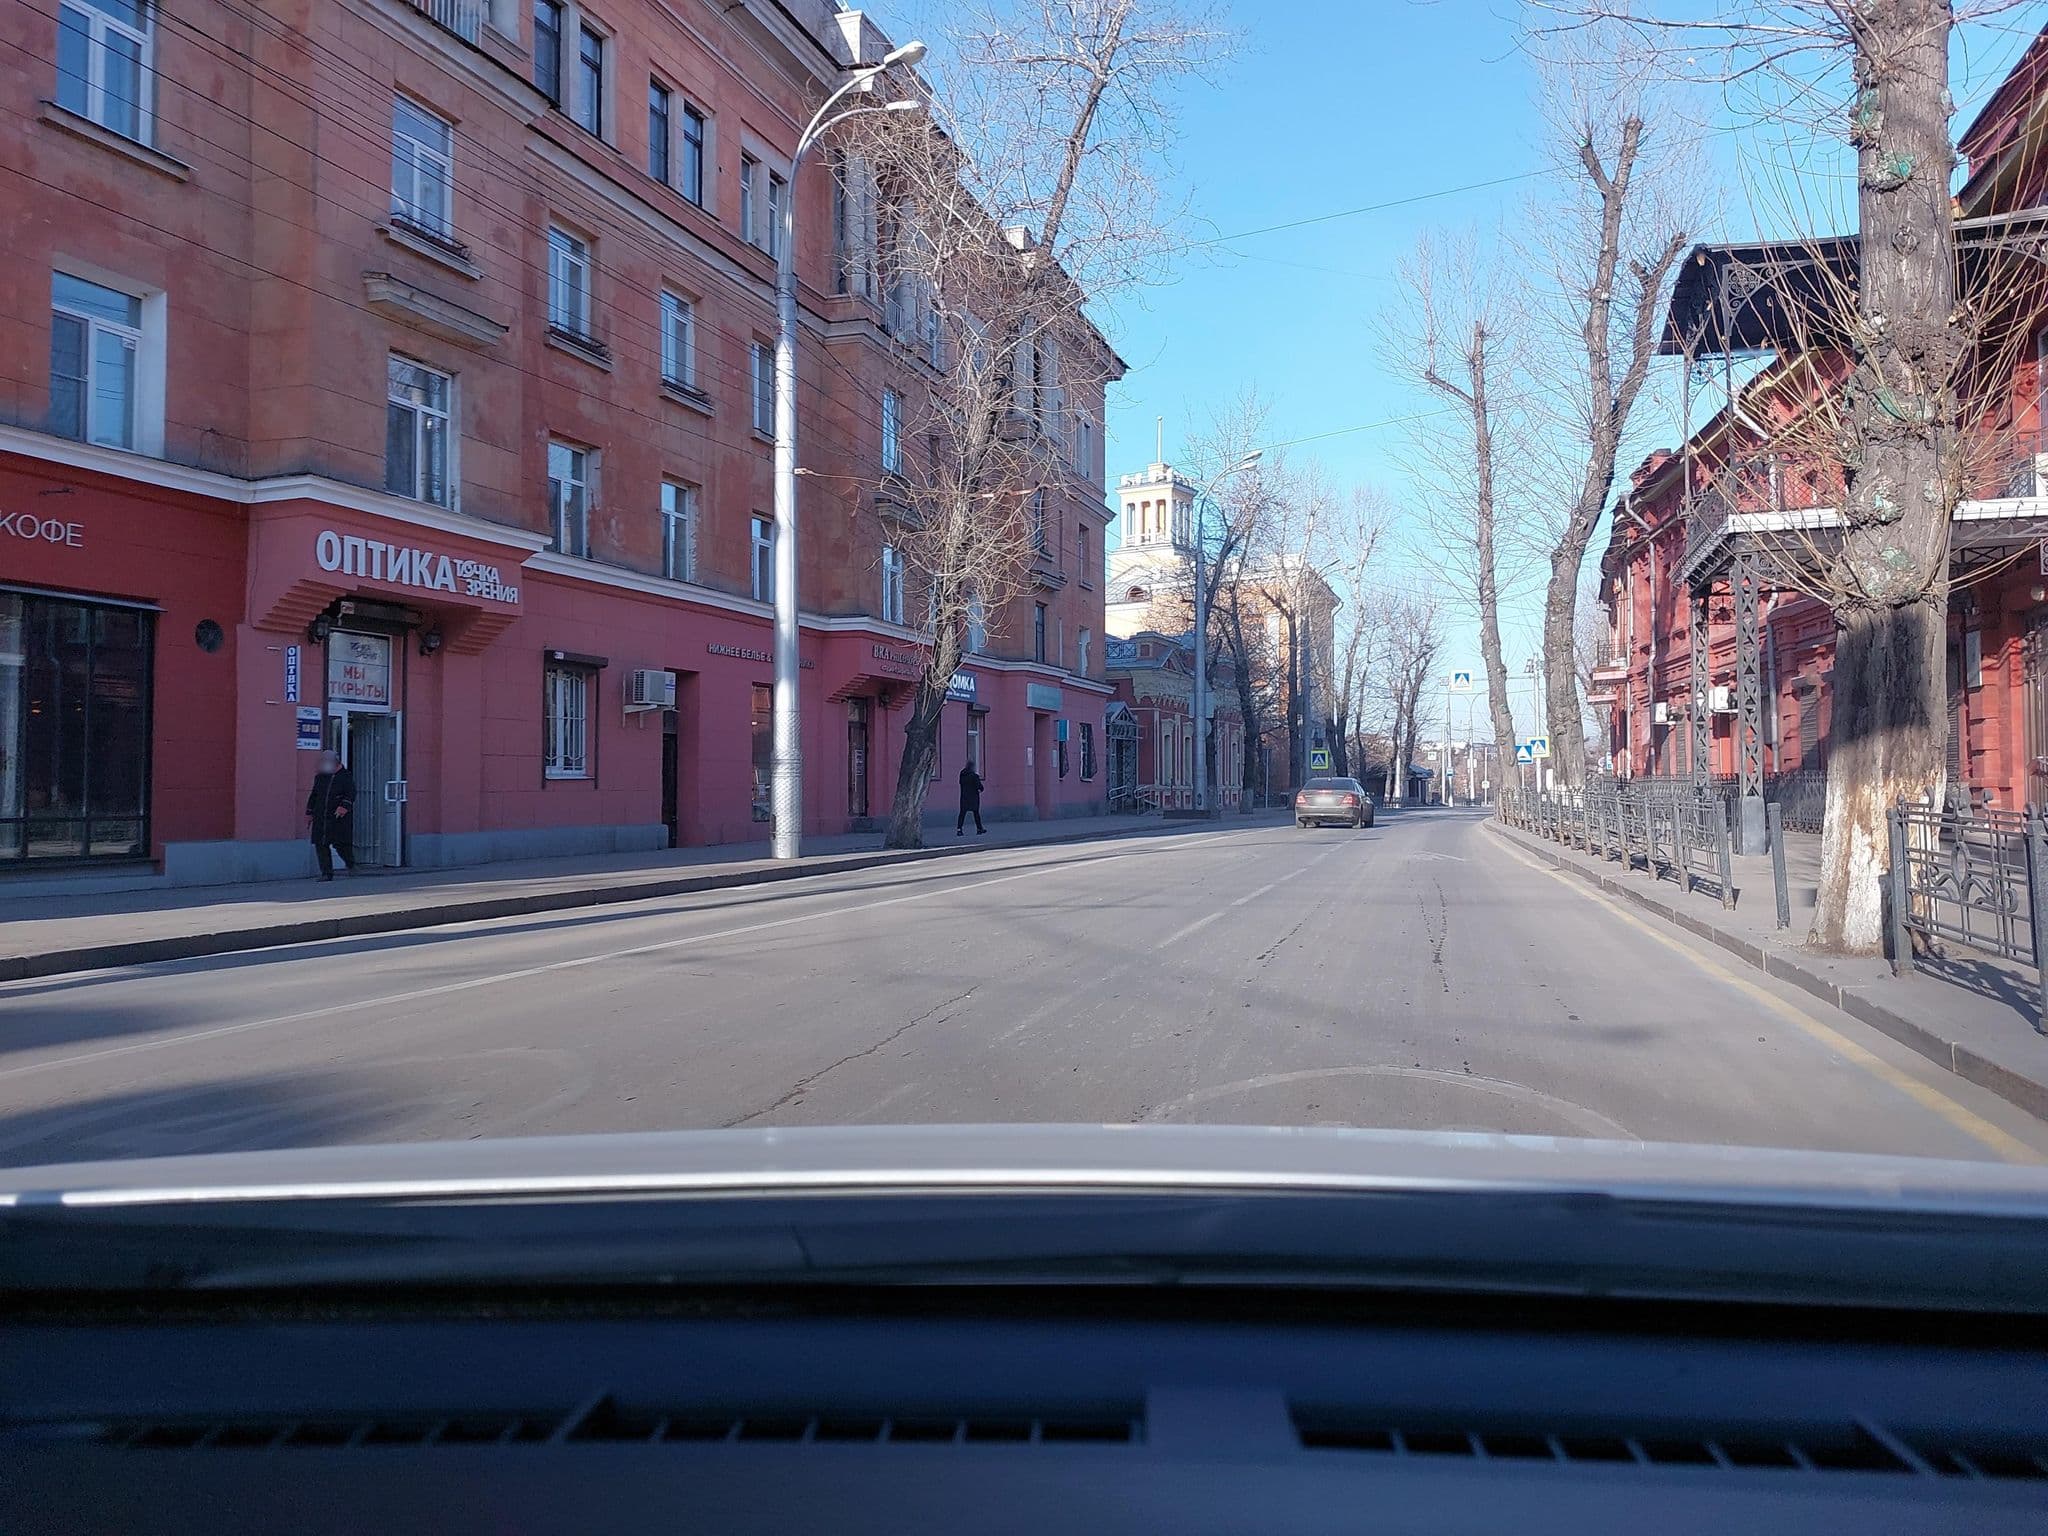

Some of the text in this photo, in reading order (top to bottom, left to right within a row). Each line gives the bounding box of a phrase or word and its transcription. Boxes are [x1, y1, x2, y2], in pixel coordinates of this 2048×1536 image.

[0, 510, 84, 547] КОФЕ
[316, 530, 457, 592] ОПТИКА
[454, 558, 500, 584] ТОЧКА
[466, 578, 519, 604] ЗРЕНИЯ
[708, 643, 740, 657] НИЖНЕЕ
[741, 649, 765, 661] БЕЛЬЕ
[287, 647, 297, 702] ОПТИКА
[344, 665, 366, 680] МЫ
[950, 674, 975, 692] ОМКА
[329, 681, 385, 698] ТКРЫТЫ
